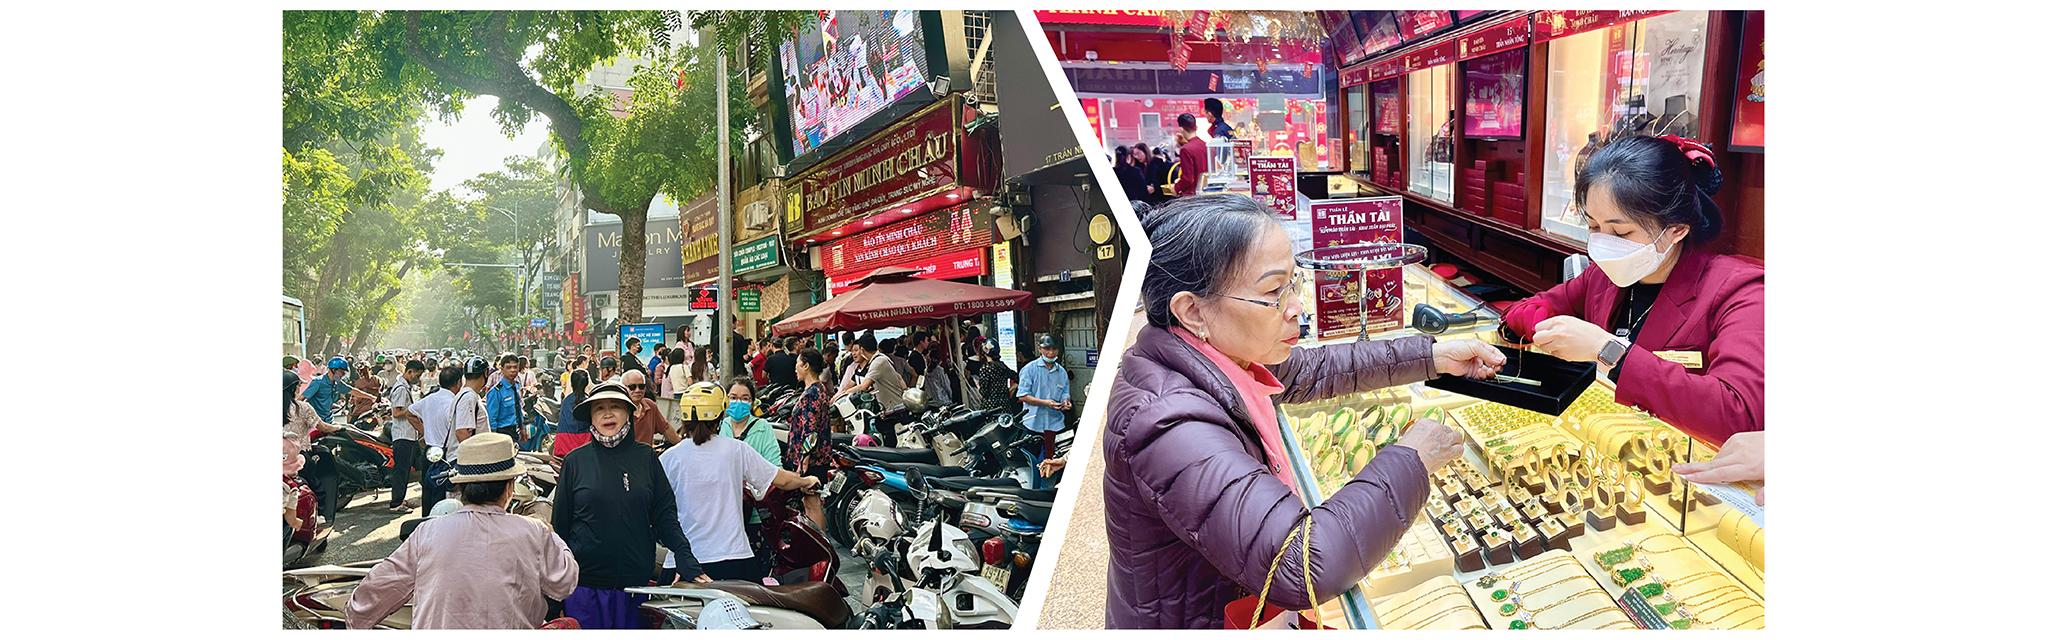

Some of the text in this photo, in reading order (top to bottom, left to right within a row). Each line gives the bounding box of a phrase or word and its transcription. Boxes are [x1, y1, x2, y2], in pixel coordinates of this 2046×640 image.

[852, 157, 896, 193] MINH
[896, 130, 948, 176] CHÂU
[1328, 209, 1391, 225] THẦN TÀI
[1092, 221, 1109, 236] TN
[1100, 246, 1111, 257] 17
[967, 301, 984, 309] 1800
[995, 299, 1005, 307] 58
[858, 313, 868, 321] 15
